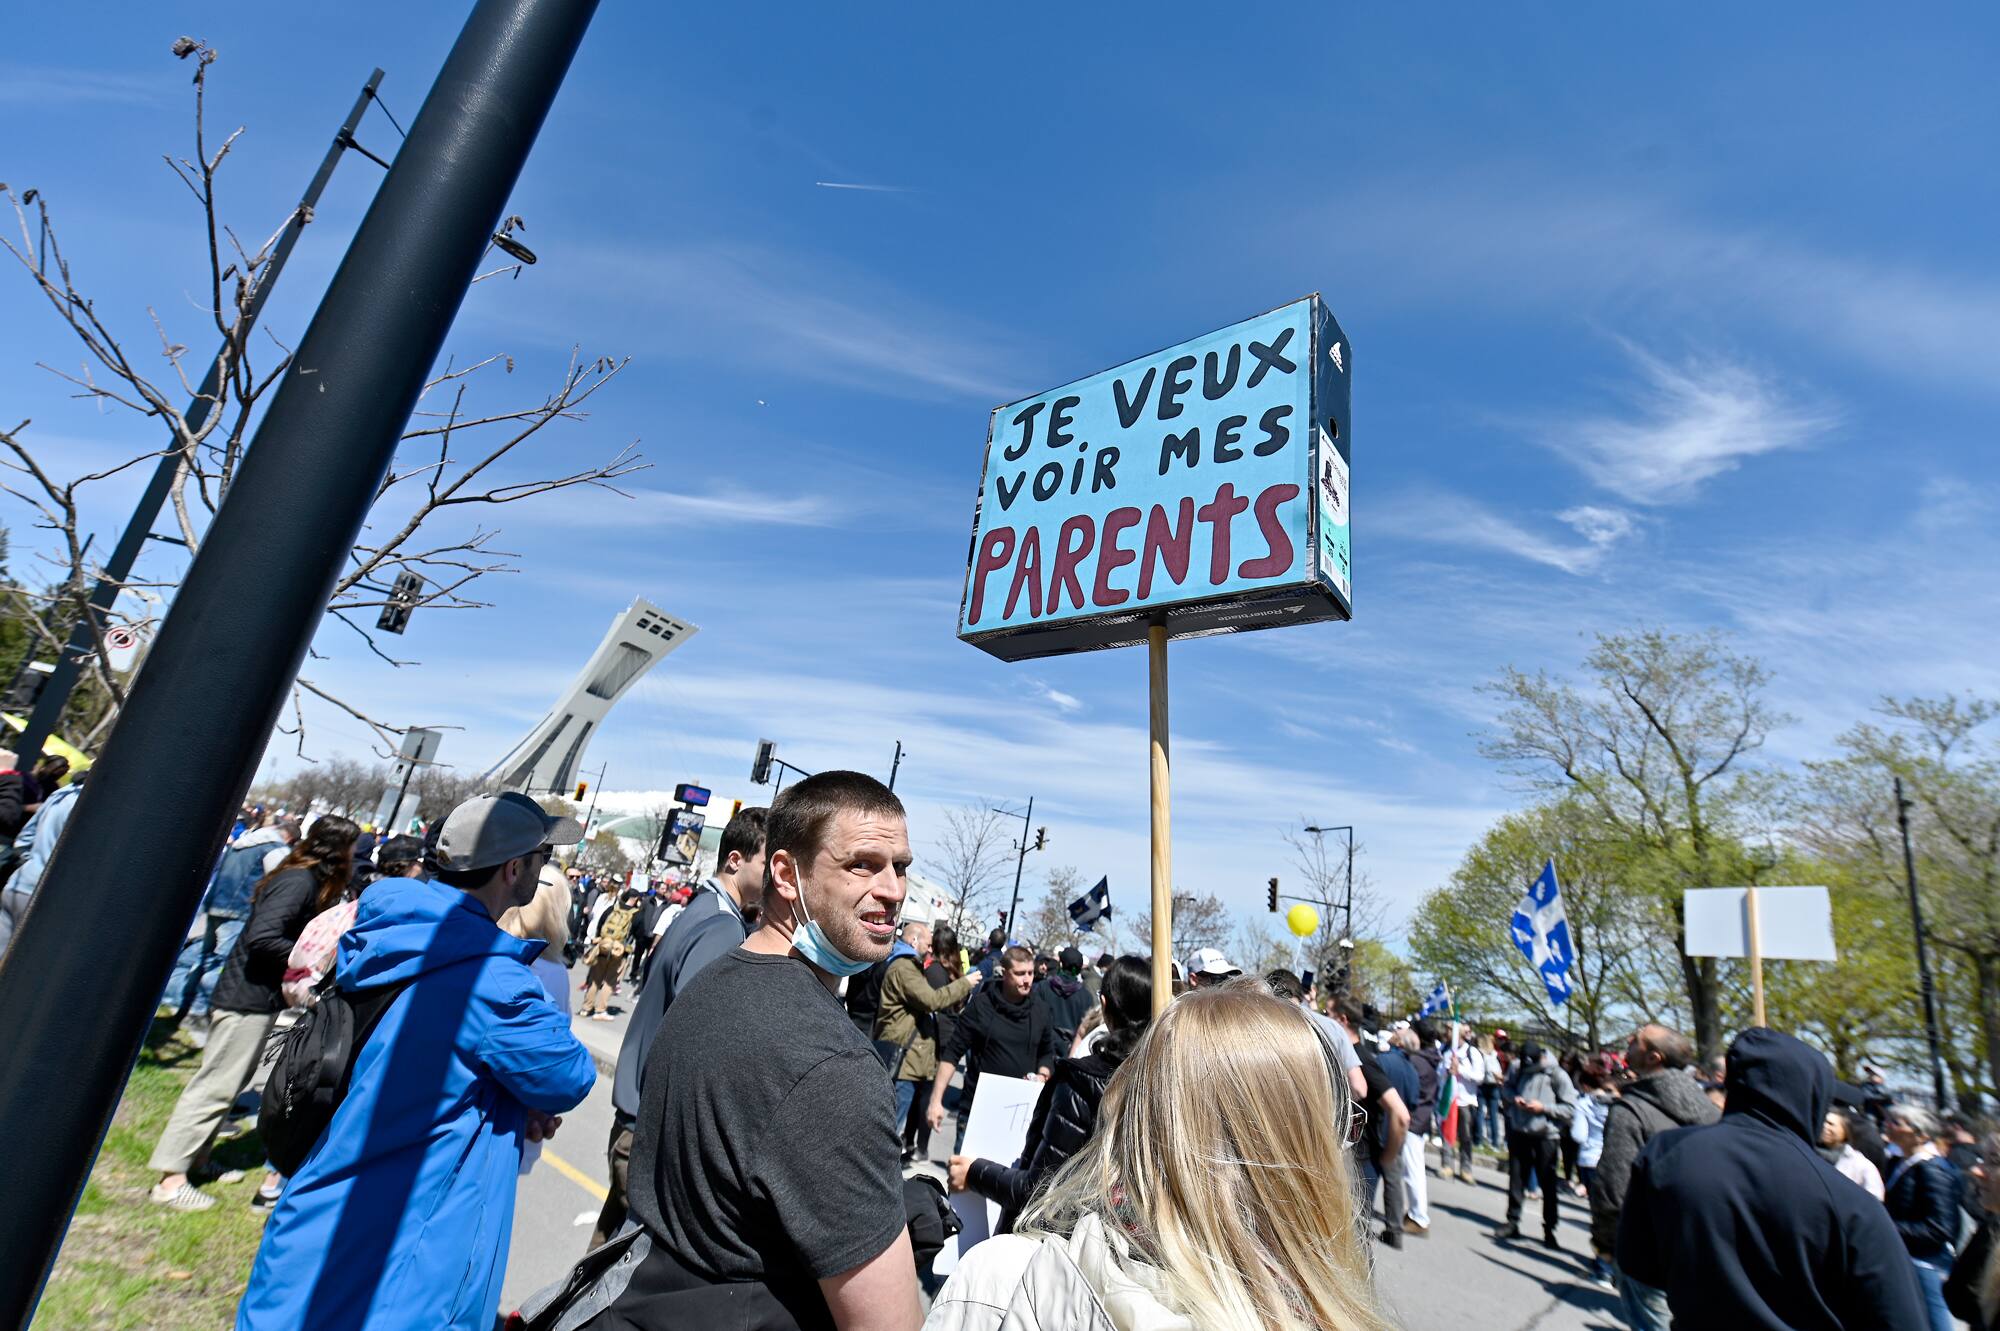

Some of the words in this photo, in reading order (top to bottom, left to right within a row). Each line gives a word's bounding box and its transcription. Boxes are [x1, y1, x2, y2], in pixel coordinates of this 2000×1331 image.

[1003, 396, 1081, 462] JE
[1112, 327, 1297, 429] VEUX
[1159, 405, 1294, 476] MES
[1217, 608, 1283, 621] Rollerblade
